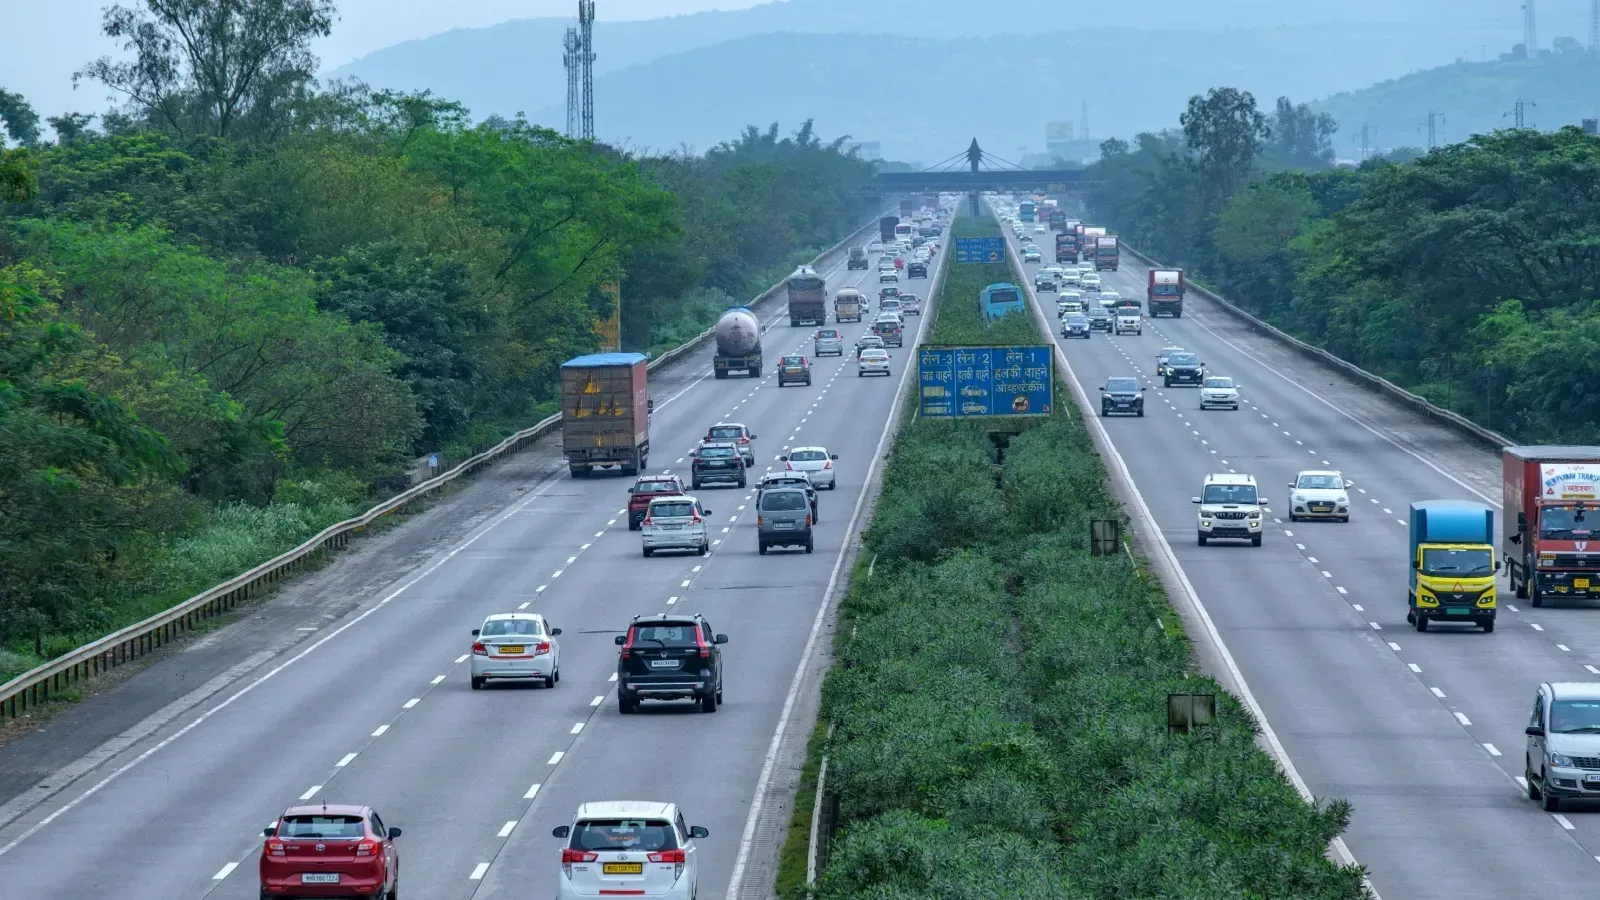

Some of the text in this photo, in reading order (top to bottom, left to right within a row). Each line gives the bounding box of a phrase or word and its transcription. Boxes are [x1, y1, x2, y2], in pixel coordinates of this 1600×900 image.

[922, 351, 953, 364] लेन -3
[957, 350, 989, 363] लेन -2
[1006, 349, 1035, 362] लेन -1
[935, 367, 952, 383] वाहने
[957, 366, 990, 383] हलकी वाहने
[995, 363, 1048, 380] हलकी वाहने
